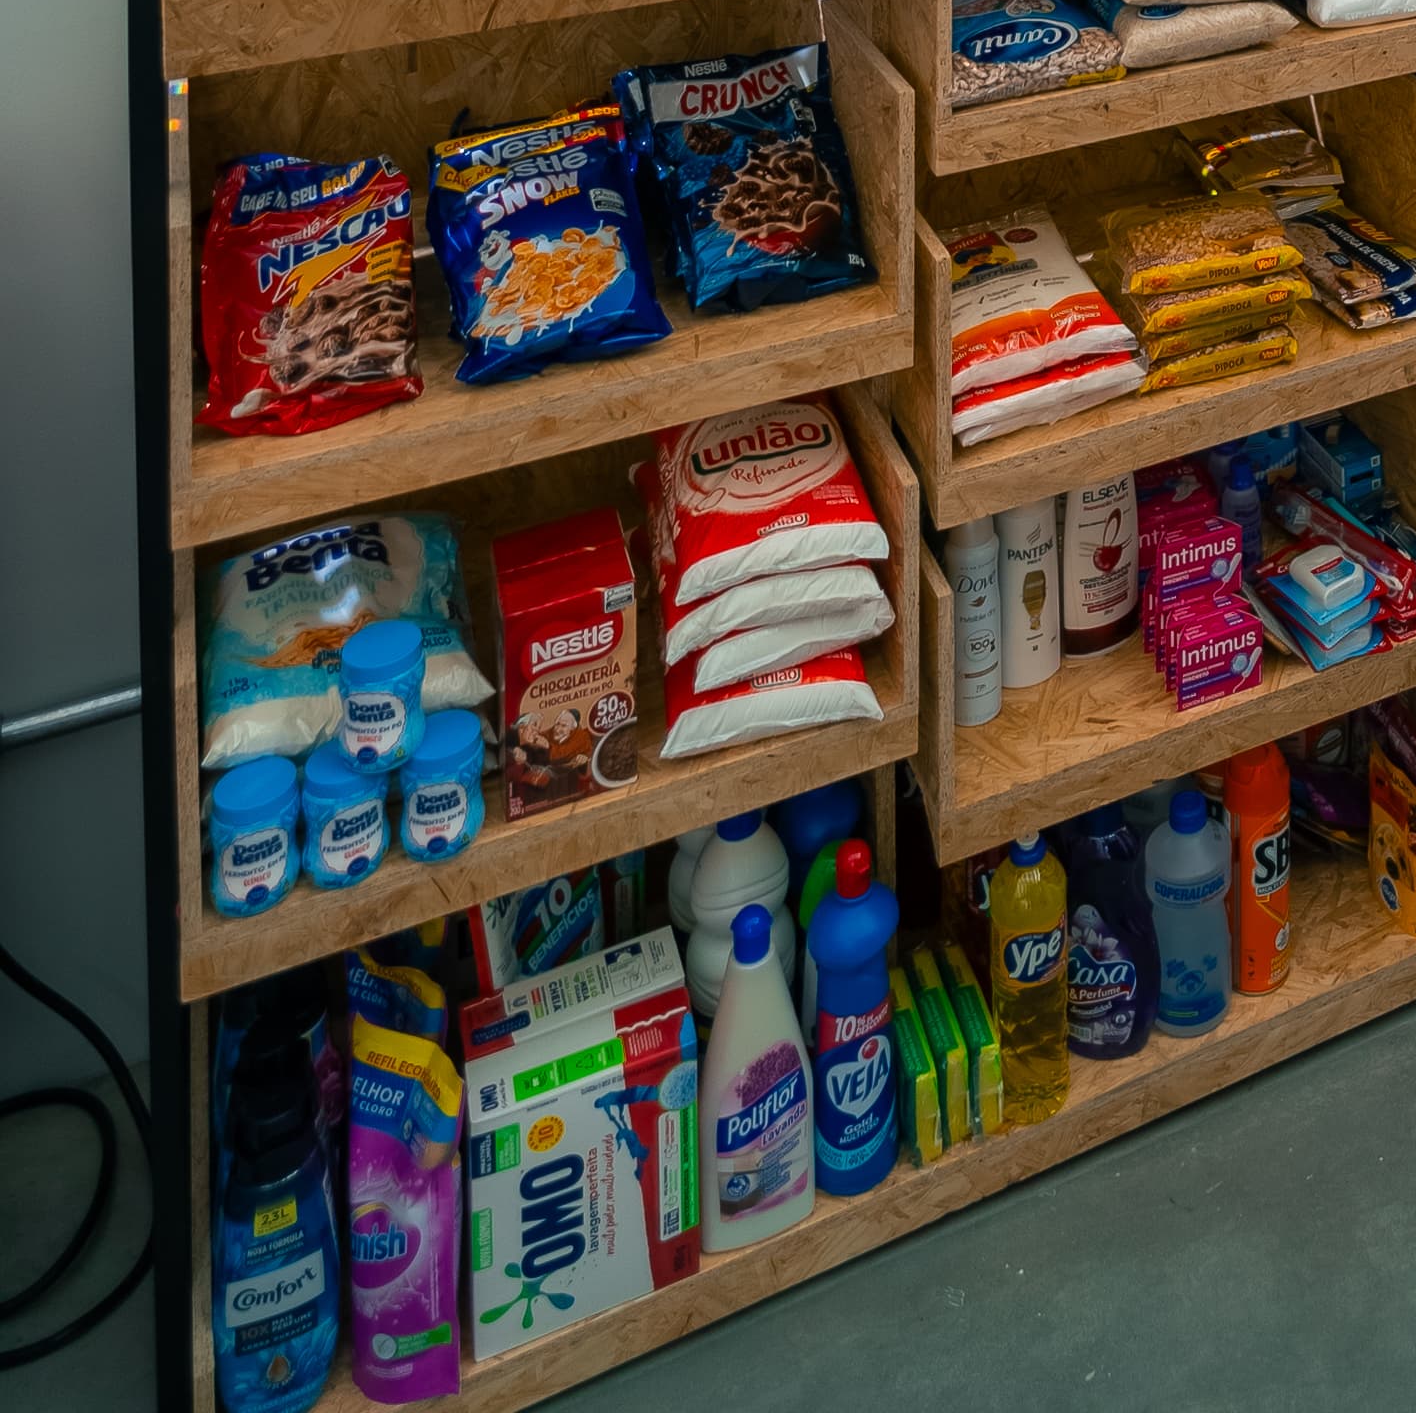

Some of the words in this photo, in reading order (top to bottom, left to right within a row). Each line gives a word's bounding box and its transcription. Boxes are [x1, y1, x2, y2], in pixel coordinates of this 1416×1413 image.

[969, 24, 1064, 58] Camil
[684, 59, 728, 77] Nestlé
[680, 61, 789, 115] CRUNCH
[479, 171, 579, 229] SNOW
[543, 186, 580, 205] FLAKES
[258, 189, 412, 294] NESCAU
[1209, 267, 1241, 279] PIPOCA
[1221, 301, 1253, 314] PIPOCA
[1215, 358, 1245, 371] PIPOCA
[703, 419, 821, 467] união
[731, 457, 807, 485] Refinado
[1082, 477, 1128, 505] ELSEVE
[245, 536, 390, 592] Benta
[1162, 535, 1236, 570] Intimus
[531, 620, 615, 665] Nestlé
[1181, 631, 1256, 668] Intimus
[347, 701, 392, 714] Dona
[538, 689, 589, 710] CHOCOLATE
[348, 709, 396, 723] Benta
[594, 708, 629, 729] CACAU
[416, 790, 458, 805] Dona
[416, 797, 462, 815] Benta
[332, 817, 380, 841] Benta
[334, 807, 380, 831] Dona
[233, 834, 279, 855] Dona
[233, 843, 284, 867] Benta
[534, 876, 573, 927] 10
[527, 888, 597, 972] BENEFÍCIOS
[1007, 929, 1061, 980] Ypê
[1080, 984, 1121, 1000] Perfume
[835, 1016, 857, 1043] 10
[366, 1051, 398, 1069] REFIL
[832, 1052, 891, 1108] VEJA
[480, 1082, 498, 1113] OMO
[727, 1076, 799, 1146] Poliflor
[844, 1115, 873, 1135] Gold
[519, 1153, 586, 1279] OMO
[231, 1263, 318, 1312] Comfort
